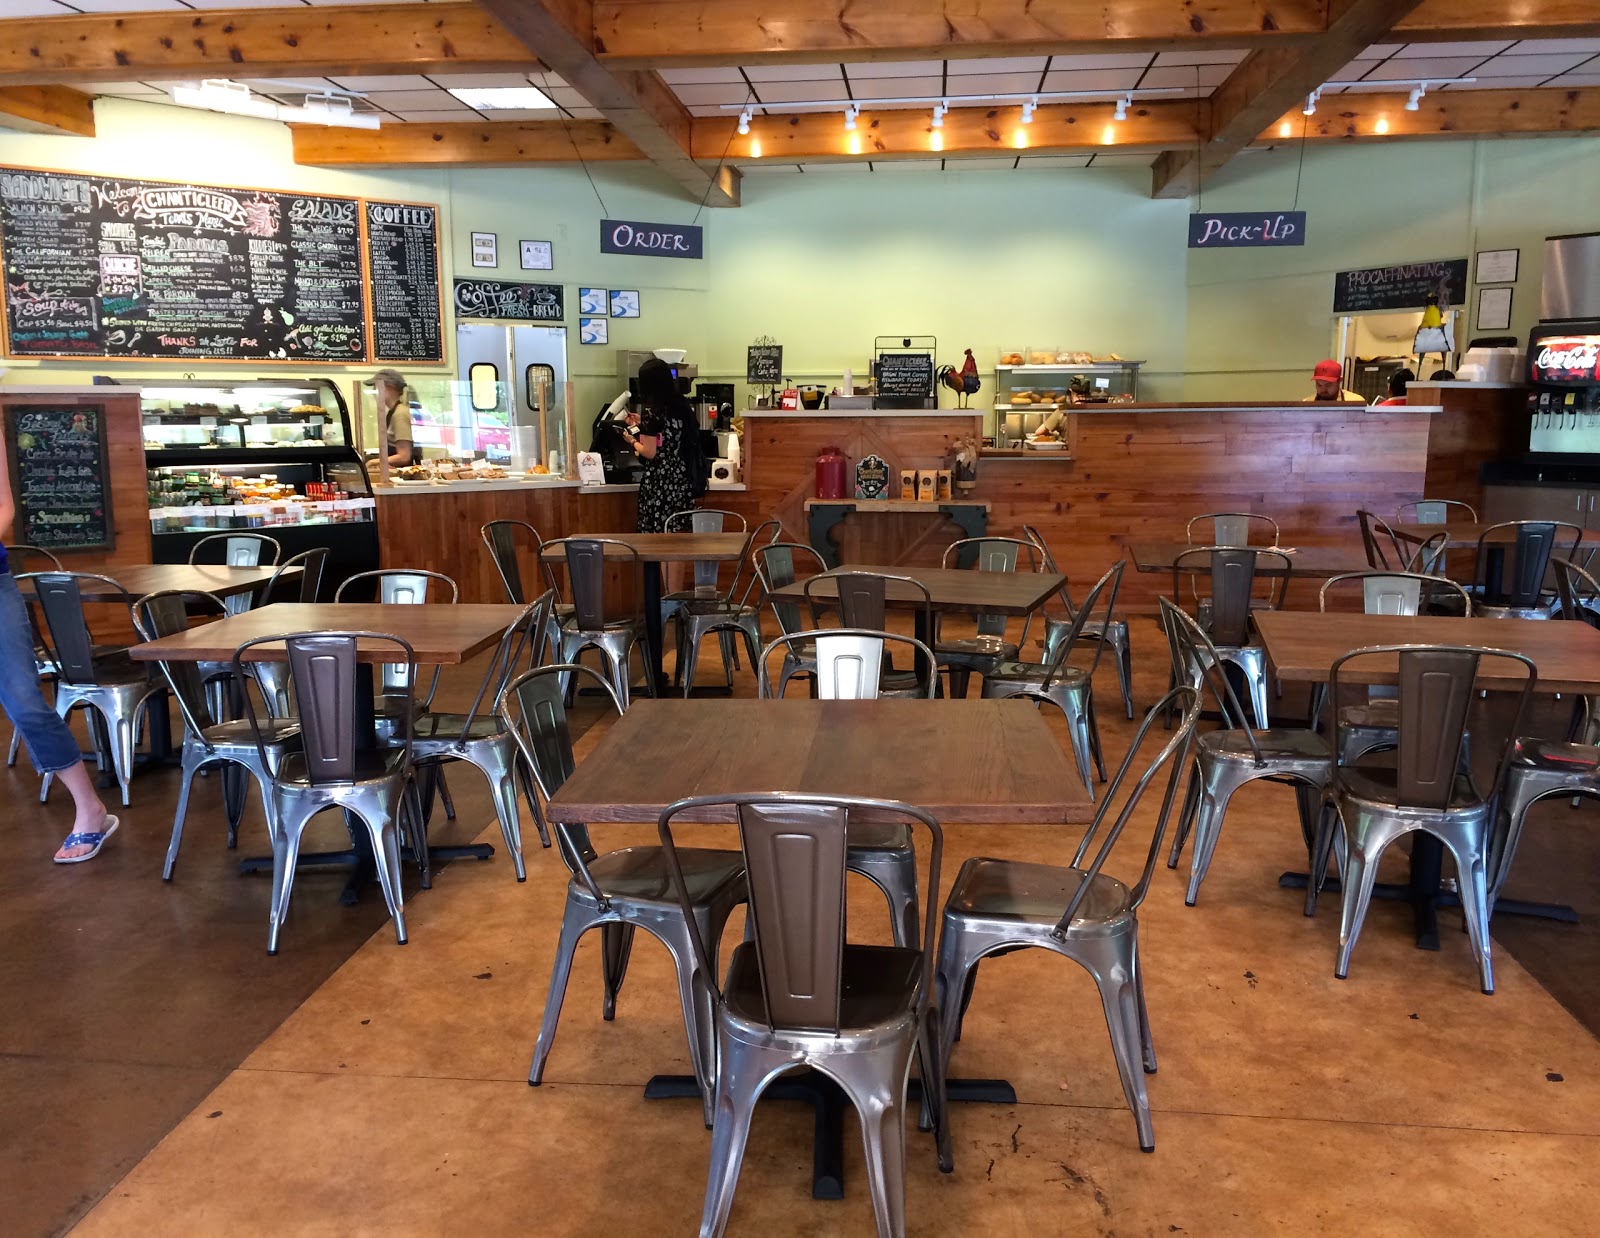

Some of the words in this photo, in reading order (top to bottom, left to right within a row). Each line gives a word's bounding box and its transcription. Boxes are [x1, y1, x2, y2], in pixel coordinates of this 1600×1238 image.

[146, 191, 233, 213] CHANTICLEER
[288, 199, 355, 221] SALADS
[373, 206, 427, 225] COFFEE
[290, 224, 306, 233] THE
[612, 224, 690, 251] ORDER
[290, 240, 316, 249] CLASSIC
[25, 247, 72, 256] CALIFORNIAN
[292, 259, 306, 267] THE
[1346, 262, 1445, 287] PROCAFFINATING
[320, 299, 337, 308] SALAD
[454, 281, 523, 318] Coffee
[23, 300, 63, 316] Soup
[147, 309, 175, 317] TOASTED
[313, 324, 333, 337] grilled
[317, 332, 329, 341] for
[157, 334, 196, 346] THANKS
[240, 337, 258, 347] FOR
[1535, 345, 1599, 370] Coca-Cola
